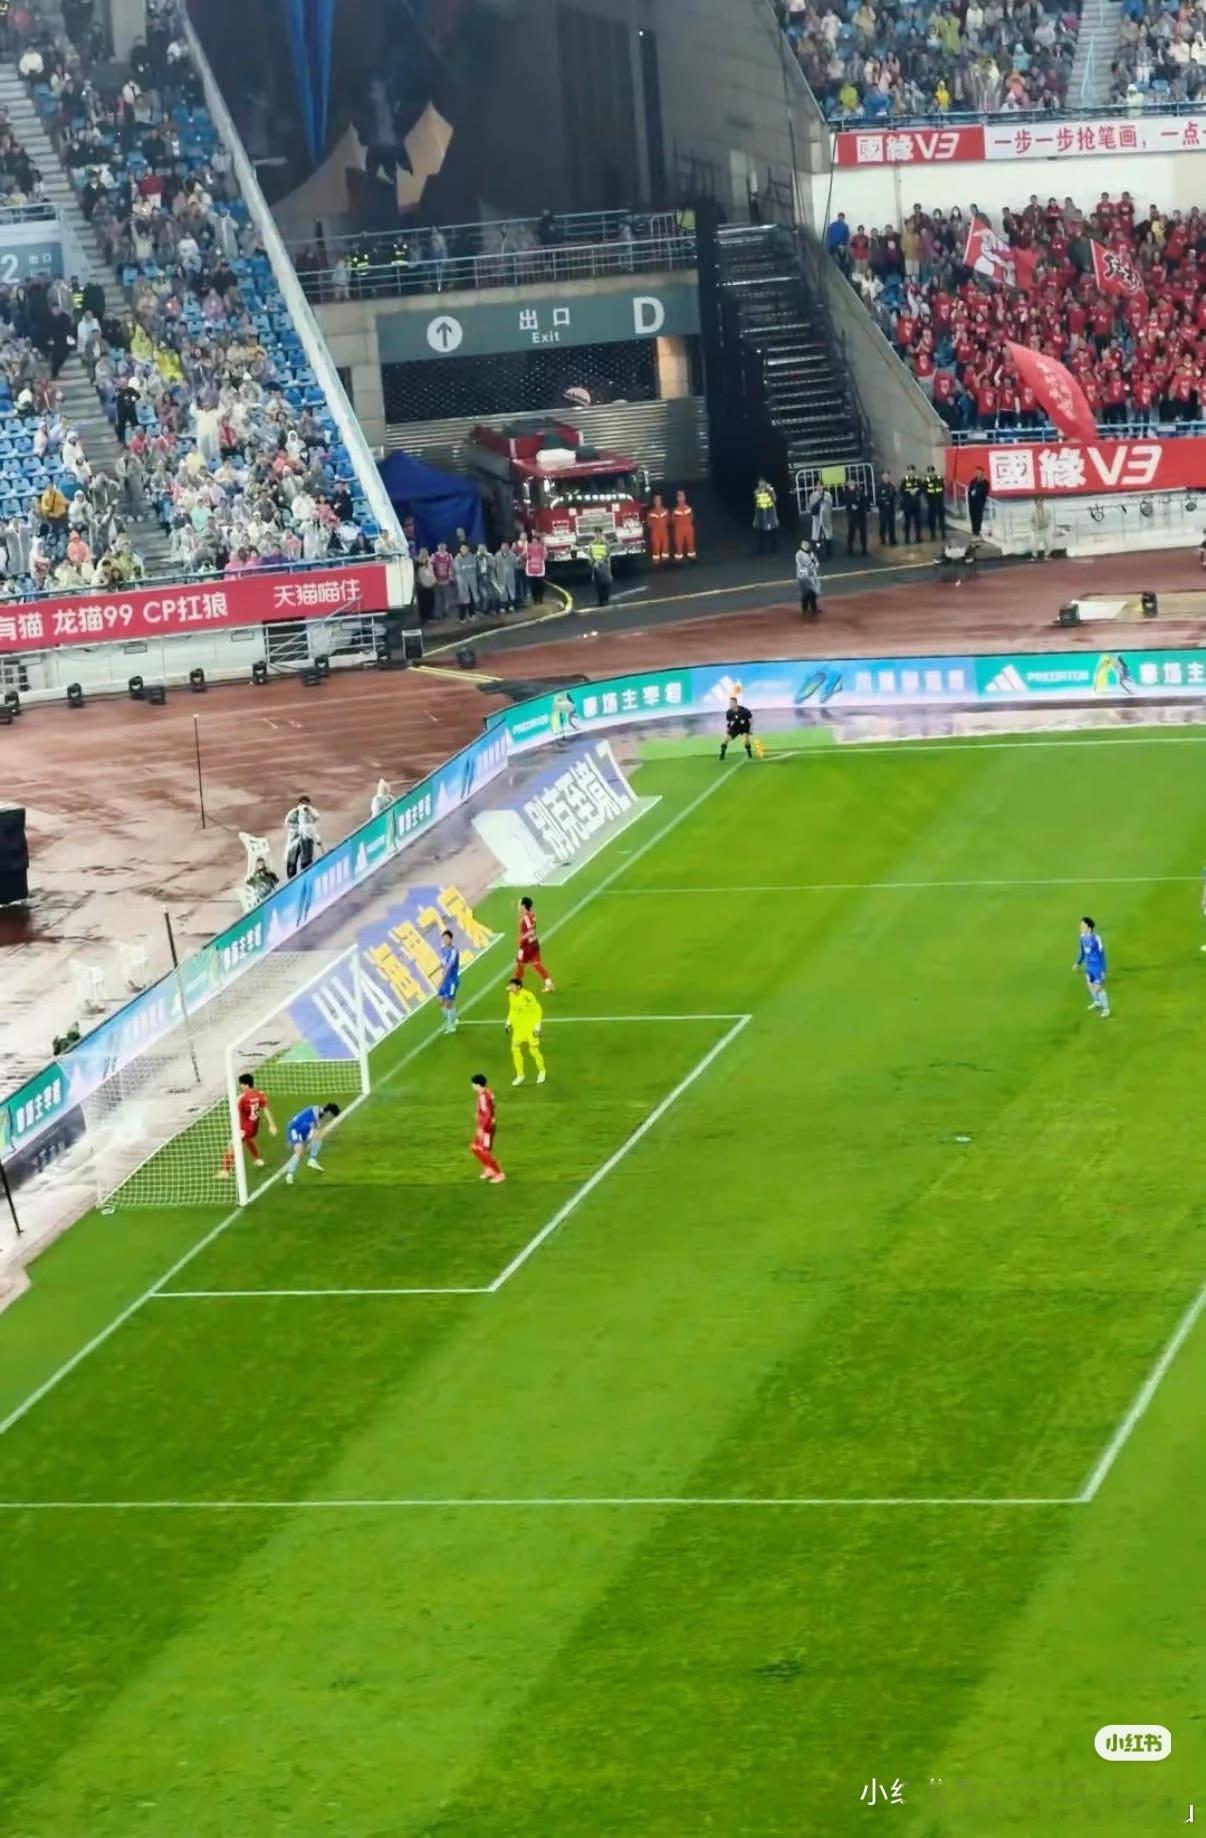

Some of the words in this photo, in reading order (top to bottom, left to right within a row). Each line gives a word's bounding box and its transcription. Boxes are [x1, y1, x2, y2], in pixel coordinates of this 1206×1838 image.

[994, 120, 1206, 154] 一步一步抢笔画，一点
[519, 307, 570, 330] 出口
[632, 296, 665, 334] D
[532, 331, 560, 344] Exit
[52, 604, 134, 636] 龙猫99
[143, 592, 228, 624] CP扛狼
